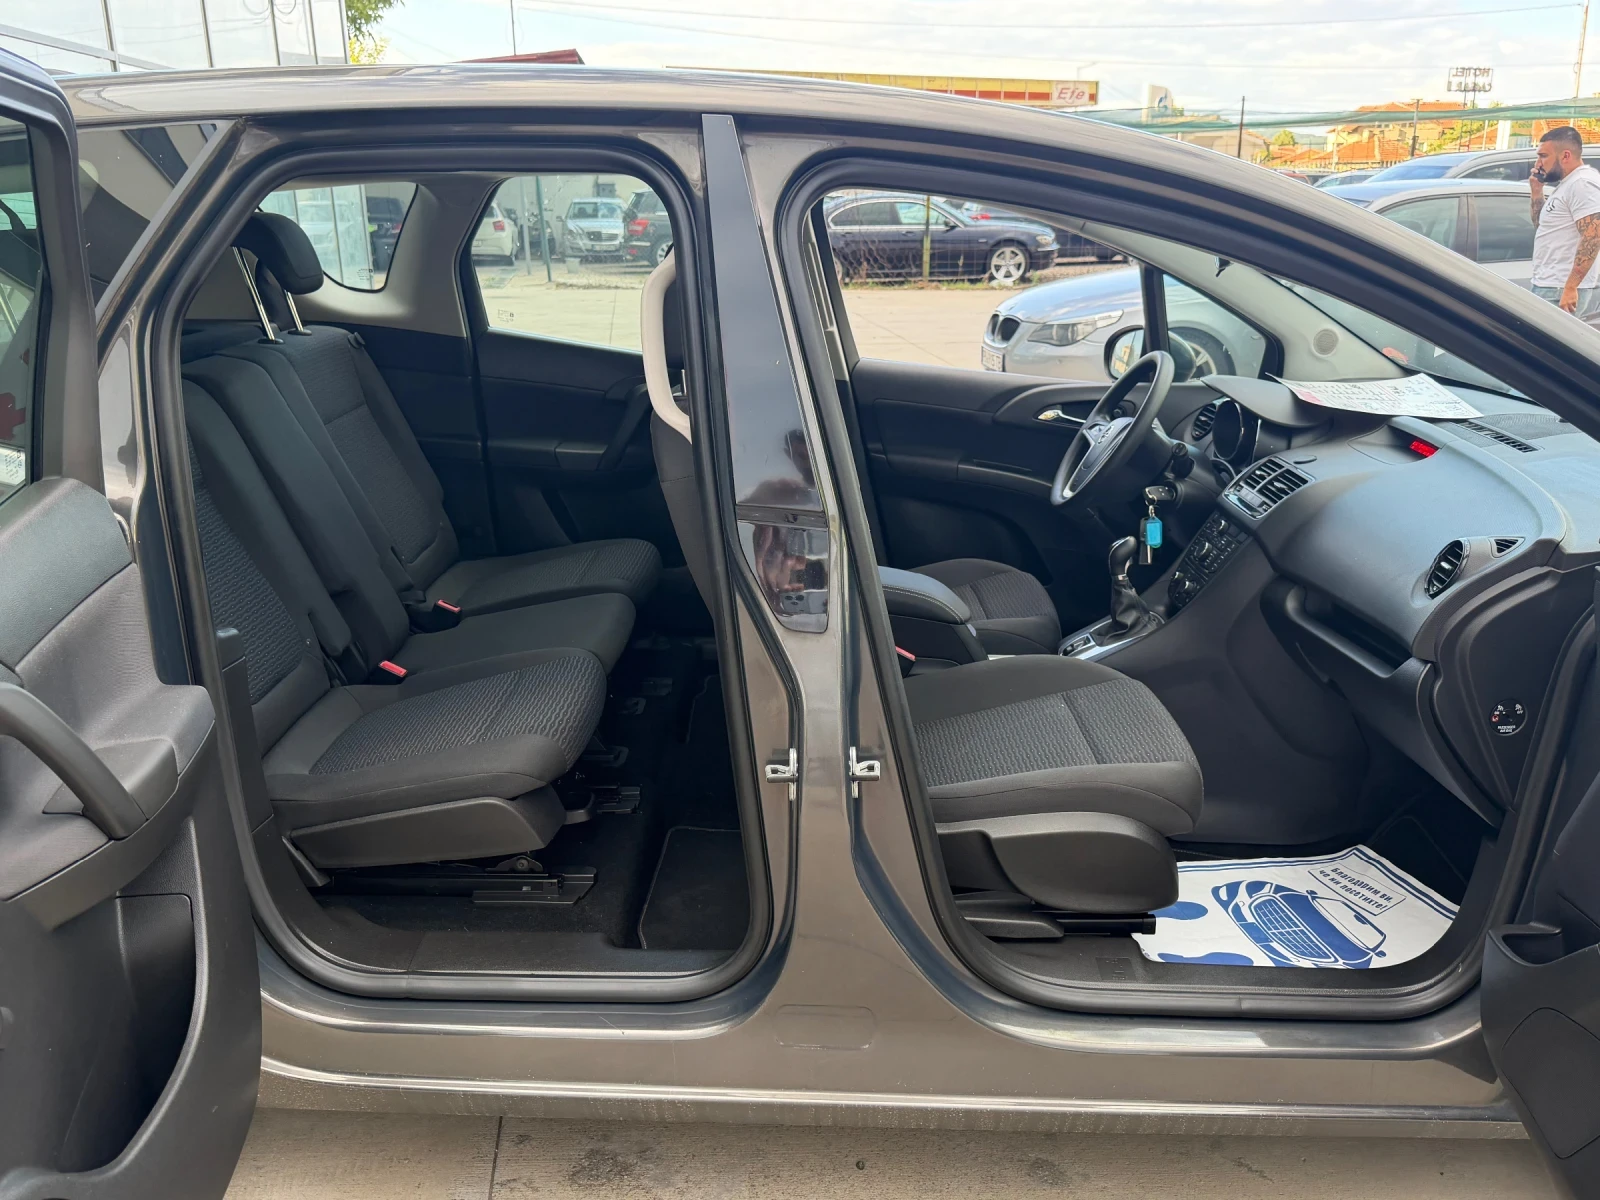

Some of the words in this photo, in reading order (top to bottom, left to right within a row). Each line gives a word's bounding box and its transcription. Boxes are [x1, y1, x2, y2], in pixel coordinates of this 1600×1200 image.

[1056, 87, 1086, 101] Efe
[1318, 869, 1331, 879] че
[1328, 876, 1342, 886] ни
[1339, 883, 1389, 911] посетихте!
[1330, 867, 1381, 896] Благодарим
